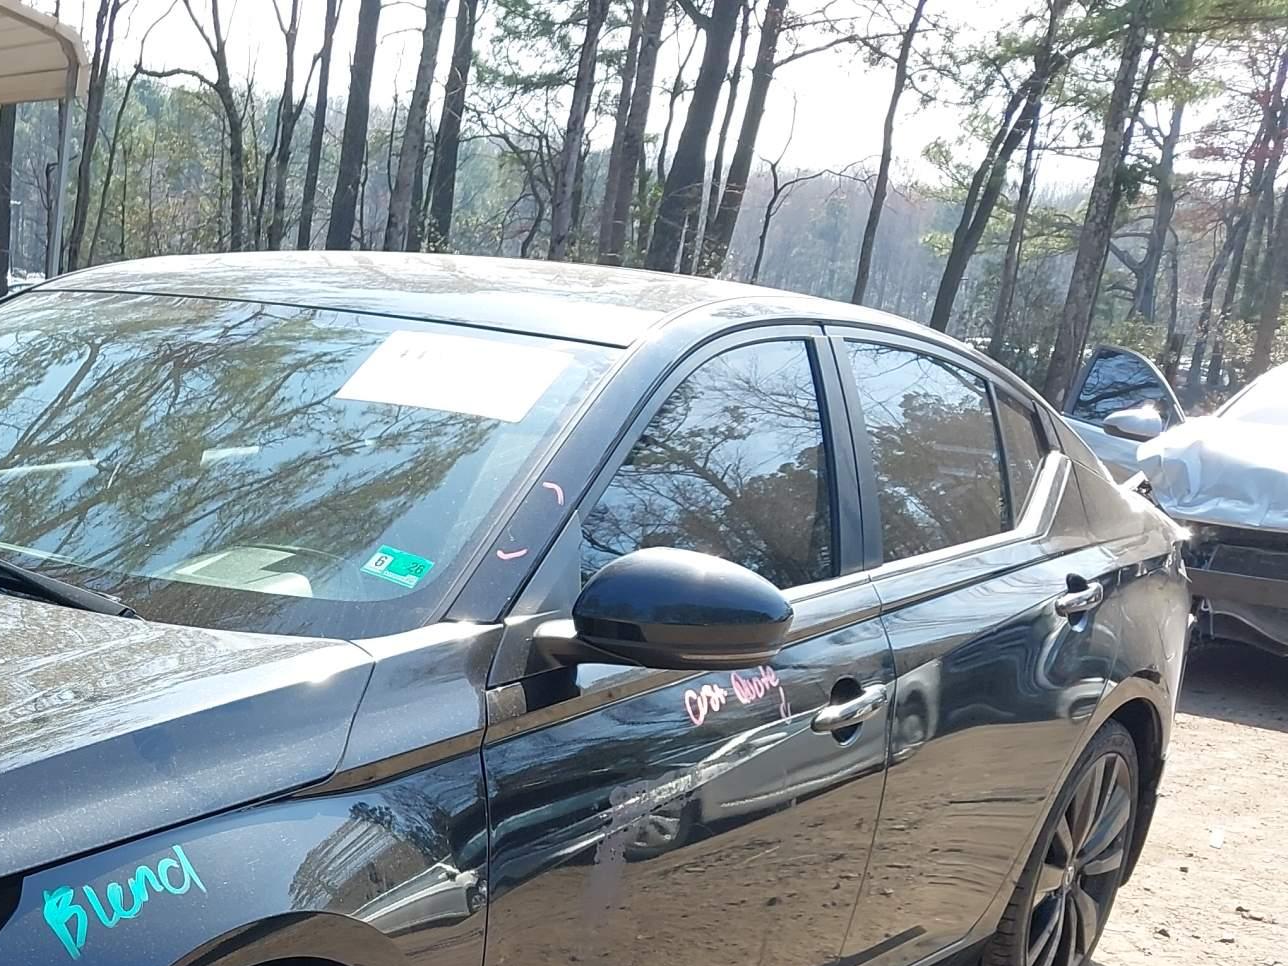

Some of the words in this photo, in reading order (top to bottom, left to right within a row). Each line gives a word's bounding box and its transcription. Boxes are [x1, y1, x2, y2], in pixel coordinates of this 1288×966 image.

[374, 555, 388, 567] 6
[406, 561, 425, 575] 26
[43, 844, 207, 960] Blend
